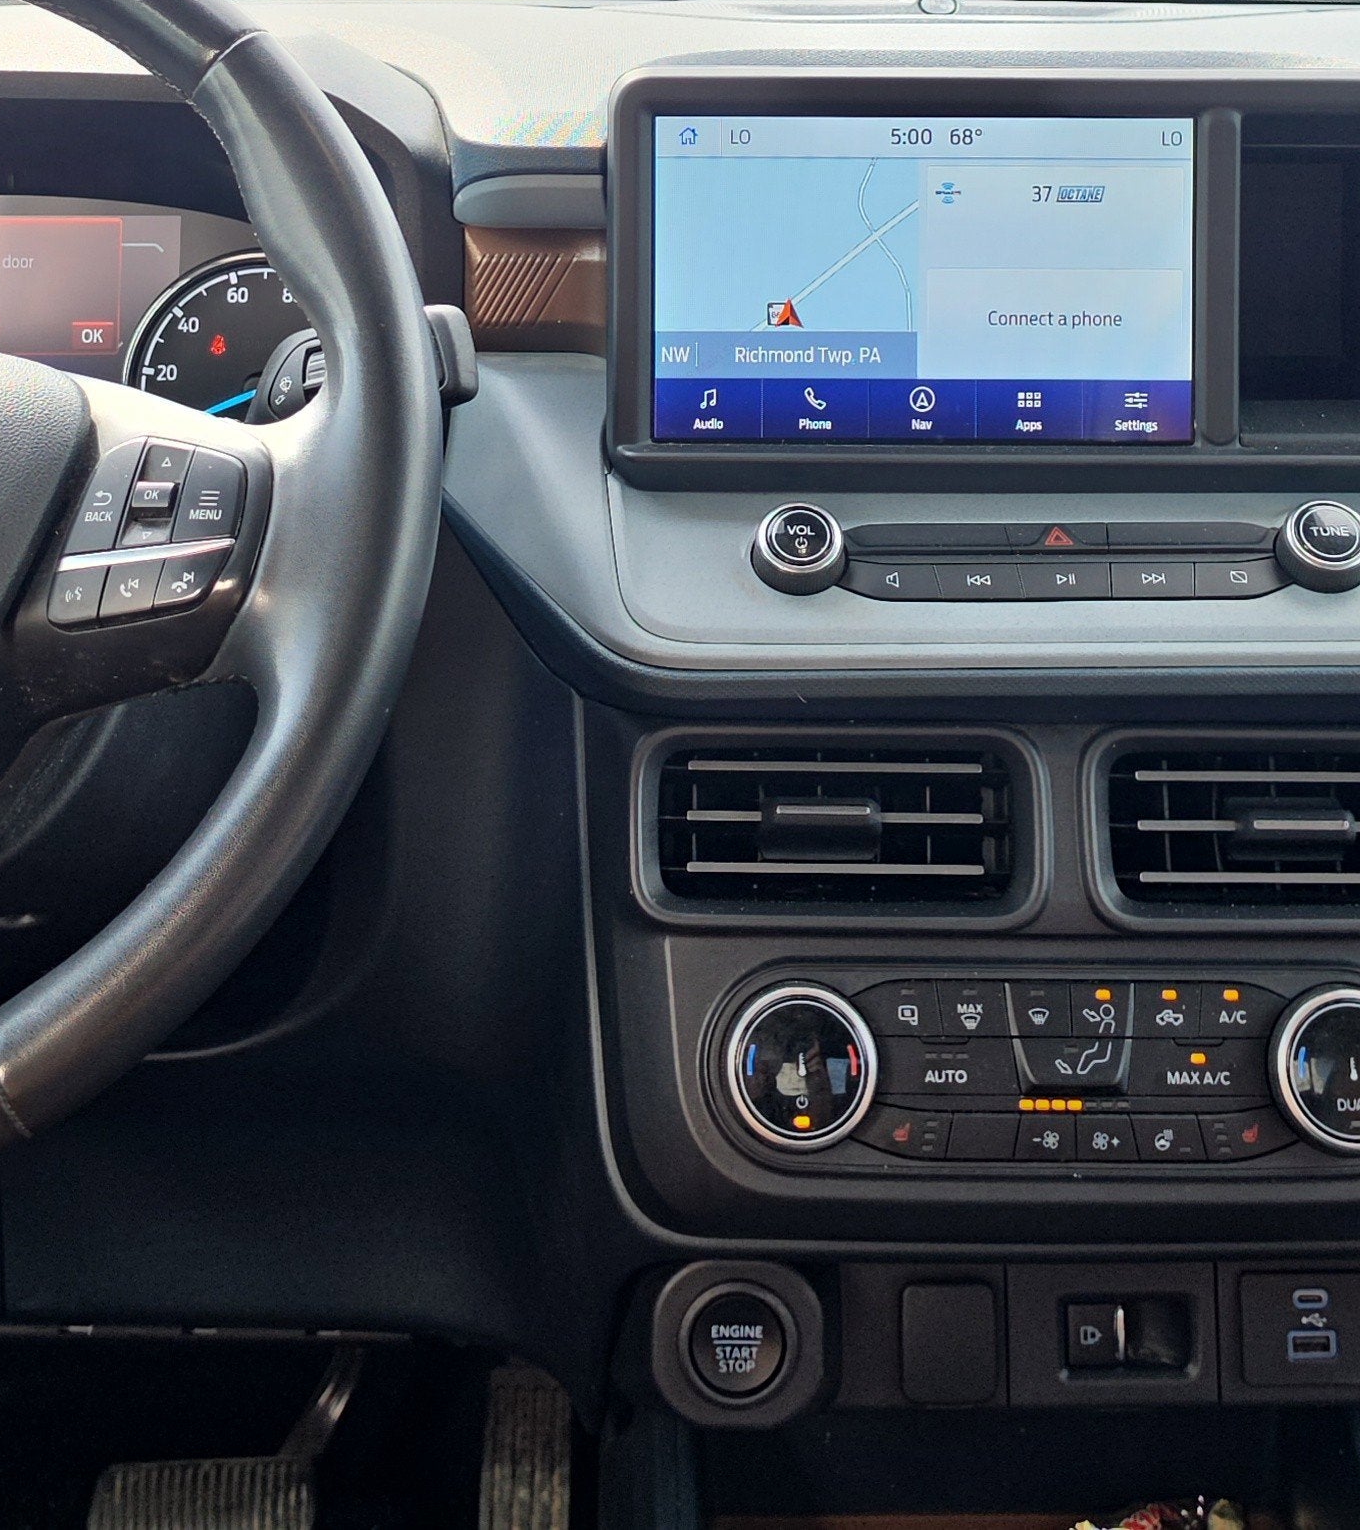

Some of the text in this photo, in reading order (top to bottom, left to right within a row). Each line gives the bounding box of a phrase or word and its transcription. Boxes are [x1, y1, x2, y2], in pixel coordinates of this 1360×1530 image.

[730, 129, 1183, 146] LO 5:00 68° LO
[1032, 186, 1105, 202] 37 OCTANE
[2, 255, 34, 269] door
[227, 287, 249, 304] 60
[177, 317, 200, 333] 40
[988, 310, 1122, 329] Connect a phone
[81, 328, 104, 344] OK
[661, 346, 691, 364] NW
[735, 346, 814, 364] Richmond
[859, 346, 882, 364] PA
[156, 364, 178, 381] 20
[693, 418, 1158, 433] Audio Phone Nav Apps Settings
[144, 490, 159, 501] OK
[84, 511, 114, 523] BACK
[189, 509, 223, 521] MENU
[786, 524, 816, 536] VOL
[1309, 525, 1350, 538] TUNE
[957, 1003, 983, 1014] MAX
[1219, 1010, 1247, 1025] A/C
[924, 1069, 968, 1084] AUTO
[1167, 1070, 1231, 1086] MAX A/C
[711, 1324, 764, 1339] ENGINE
[715, 1346, 758, 1360] START
[718, 1359, 756, 1373] STOP
